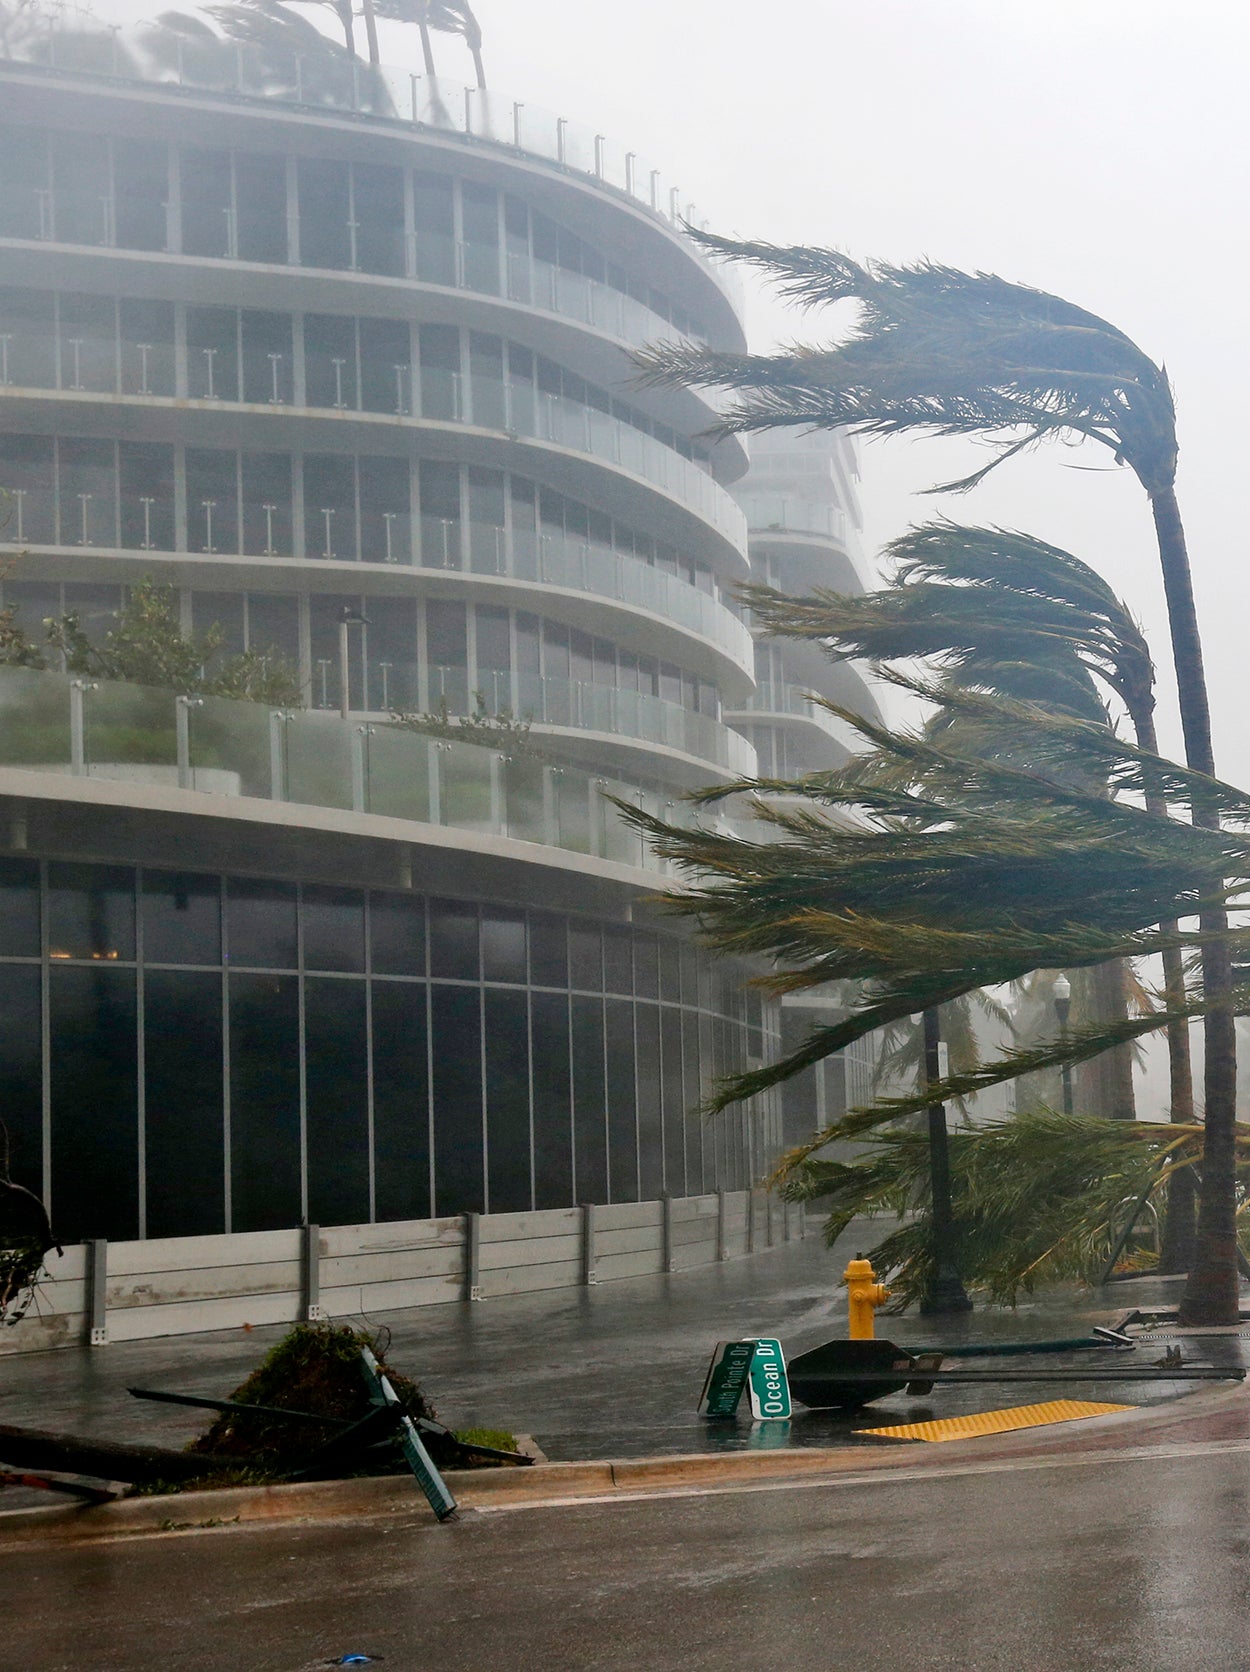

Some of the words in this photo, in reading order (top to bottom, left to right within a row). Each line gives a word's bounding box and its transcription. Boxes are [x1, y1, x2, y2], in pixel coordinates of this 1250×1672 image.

[730, 1345, 750, 1356] Dr
[756, 1341, 775, 1356] Dr
[721, 1360, 747, 1388] Pointe
[762, 1363, 784, 1413] Ocean
[712, 1391, 738, 1413] South
